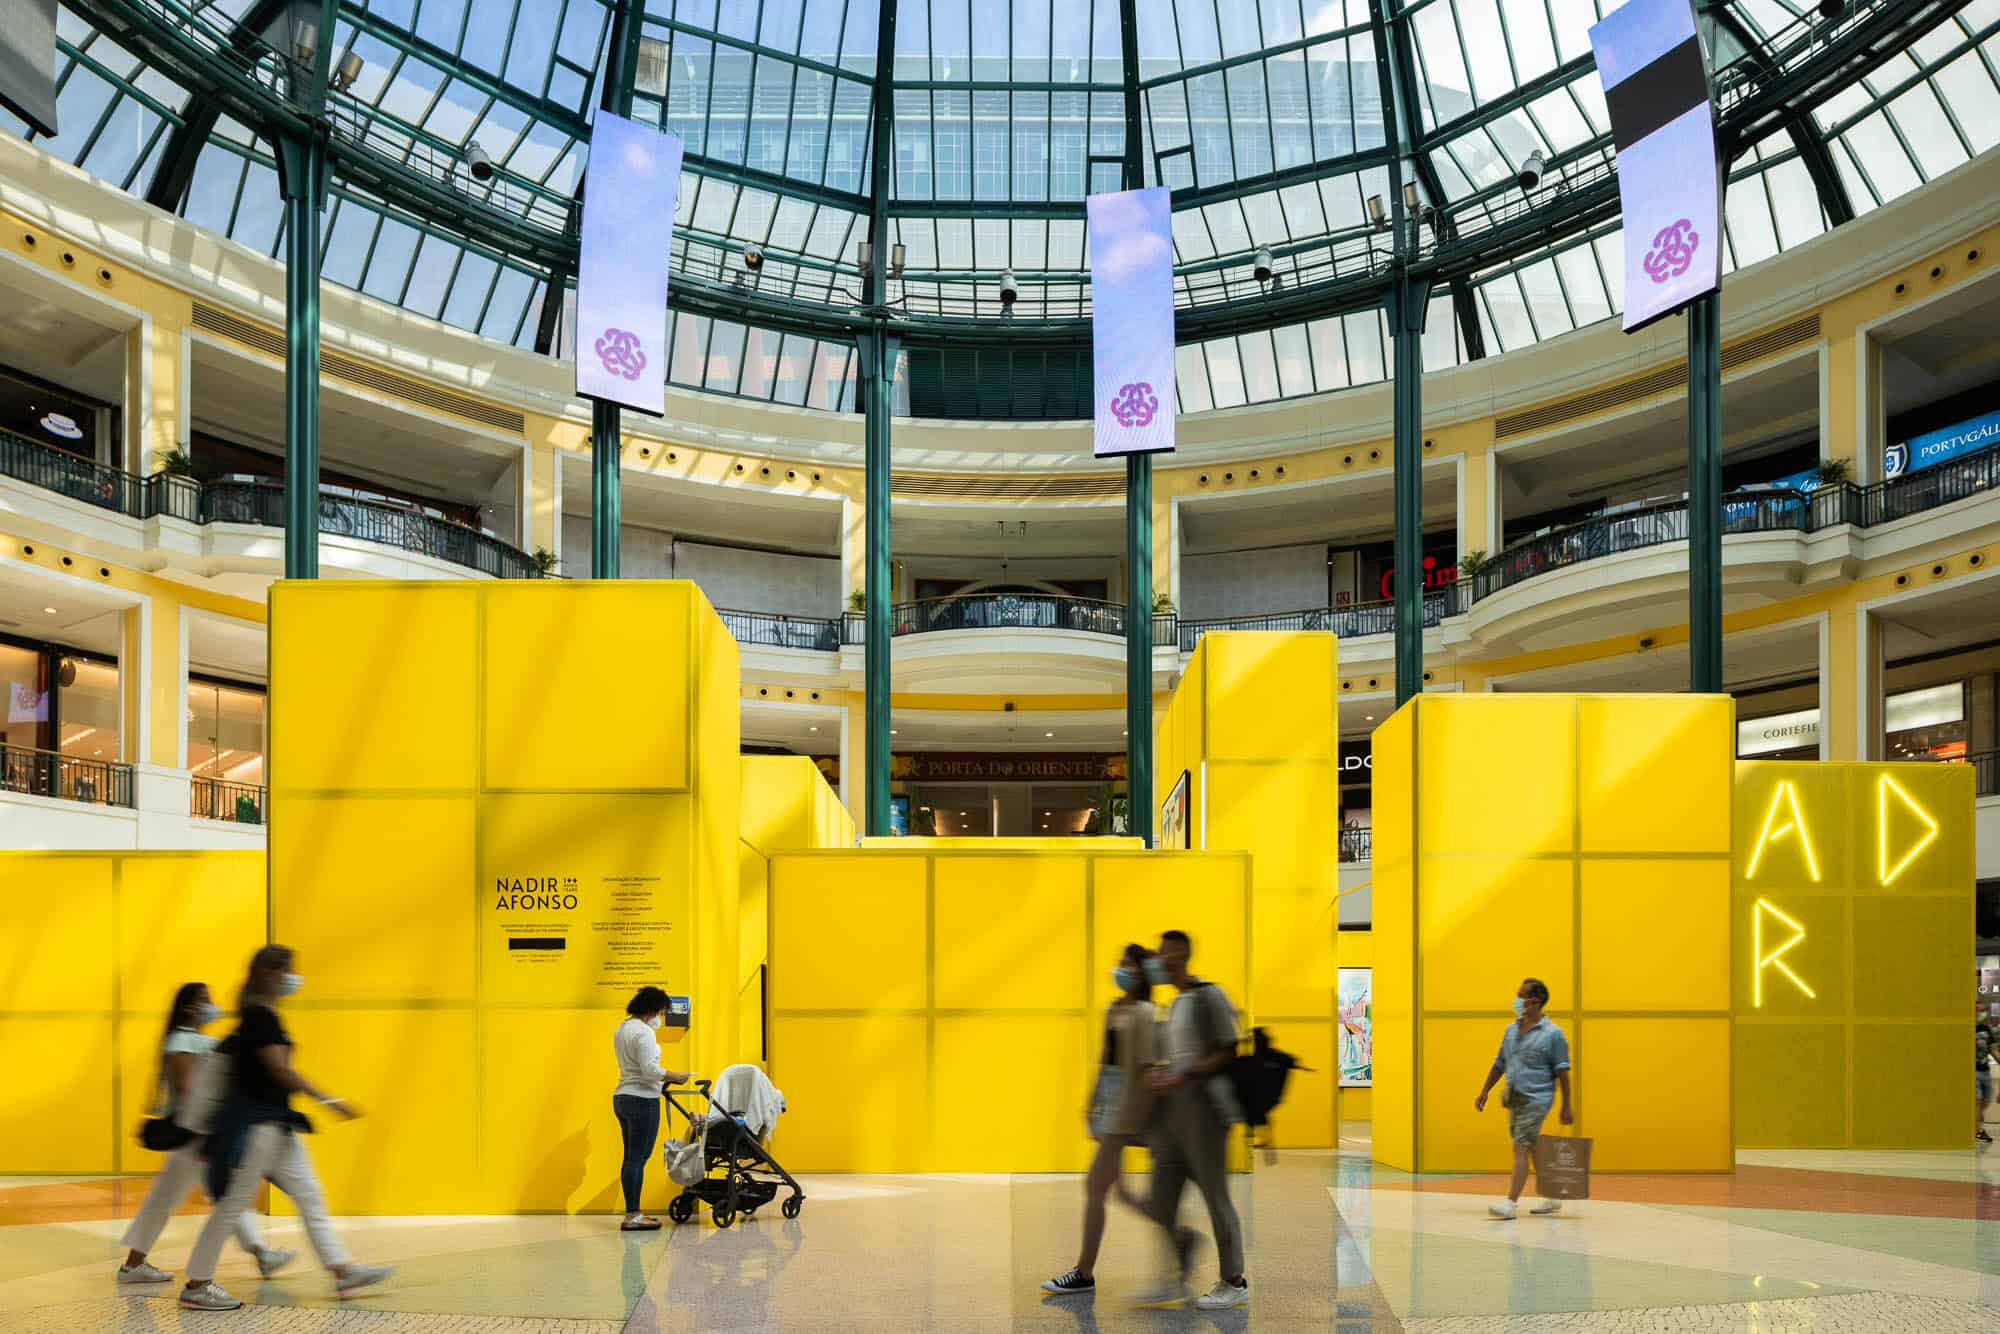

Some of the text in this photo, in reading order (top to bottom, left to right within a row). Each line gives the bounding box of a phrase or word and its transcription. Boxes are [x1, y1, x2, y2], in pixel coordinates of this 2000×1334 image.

[1921, 423, 2000, 458] PORTVGÁLI
[928, 759, 983, 776] PORTA
[1017, 759, 1094, 776] ORIENTE
[1745, 773, 1940, 885] A D
[496, 877, 558, 893] NADIR
[496, 894, 578, 910] AFONSO
[1754, 897, 1817, 1007] R
